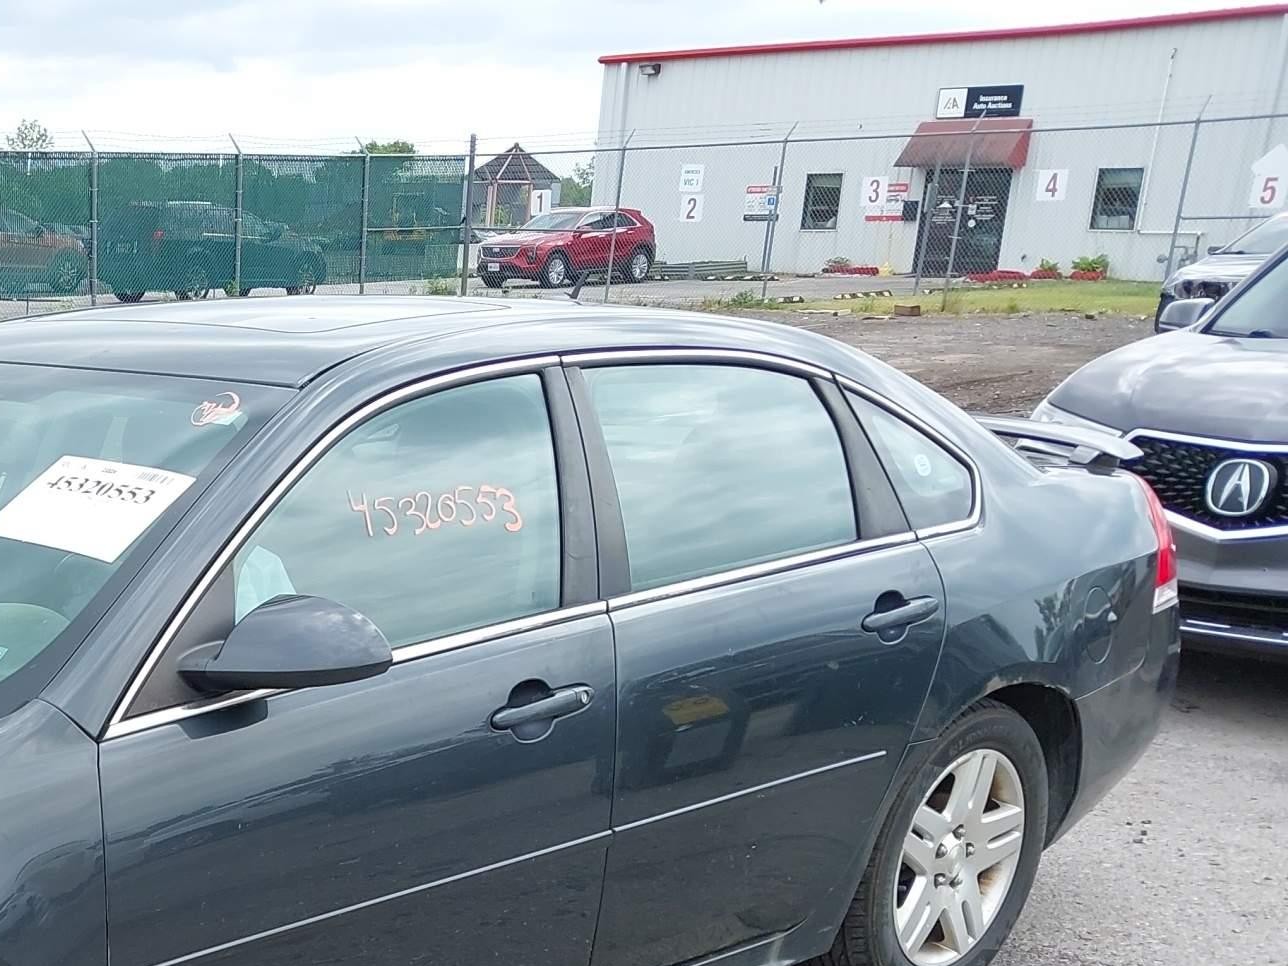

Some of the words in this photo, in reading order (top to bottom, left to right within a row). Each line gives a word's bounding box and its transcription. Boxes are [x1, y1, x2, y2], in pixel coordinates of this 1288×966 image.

[972, 102, 987, 110] Auto
[987, 101, 1013, 109] Auctions
[868, 179, 880, 204] 3
[1045, 172, 1058, 198] 4
[1260, 176, 1279, 205] 5
[536, 192, 544, 213] 1
[686, 197, 697, 220] 2
[47, 475, 156, 504] 45320553
[346, 484, 523, 537] 45320553
